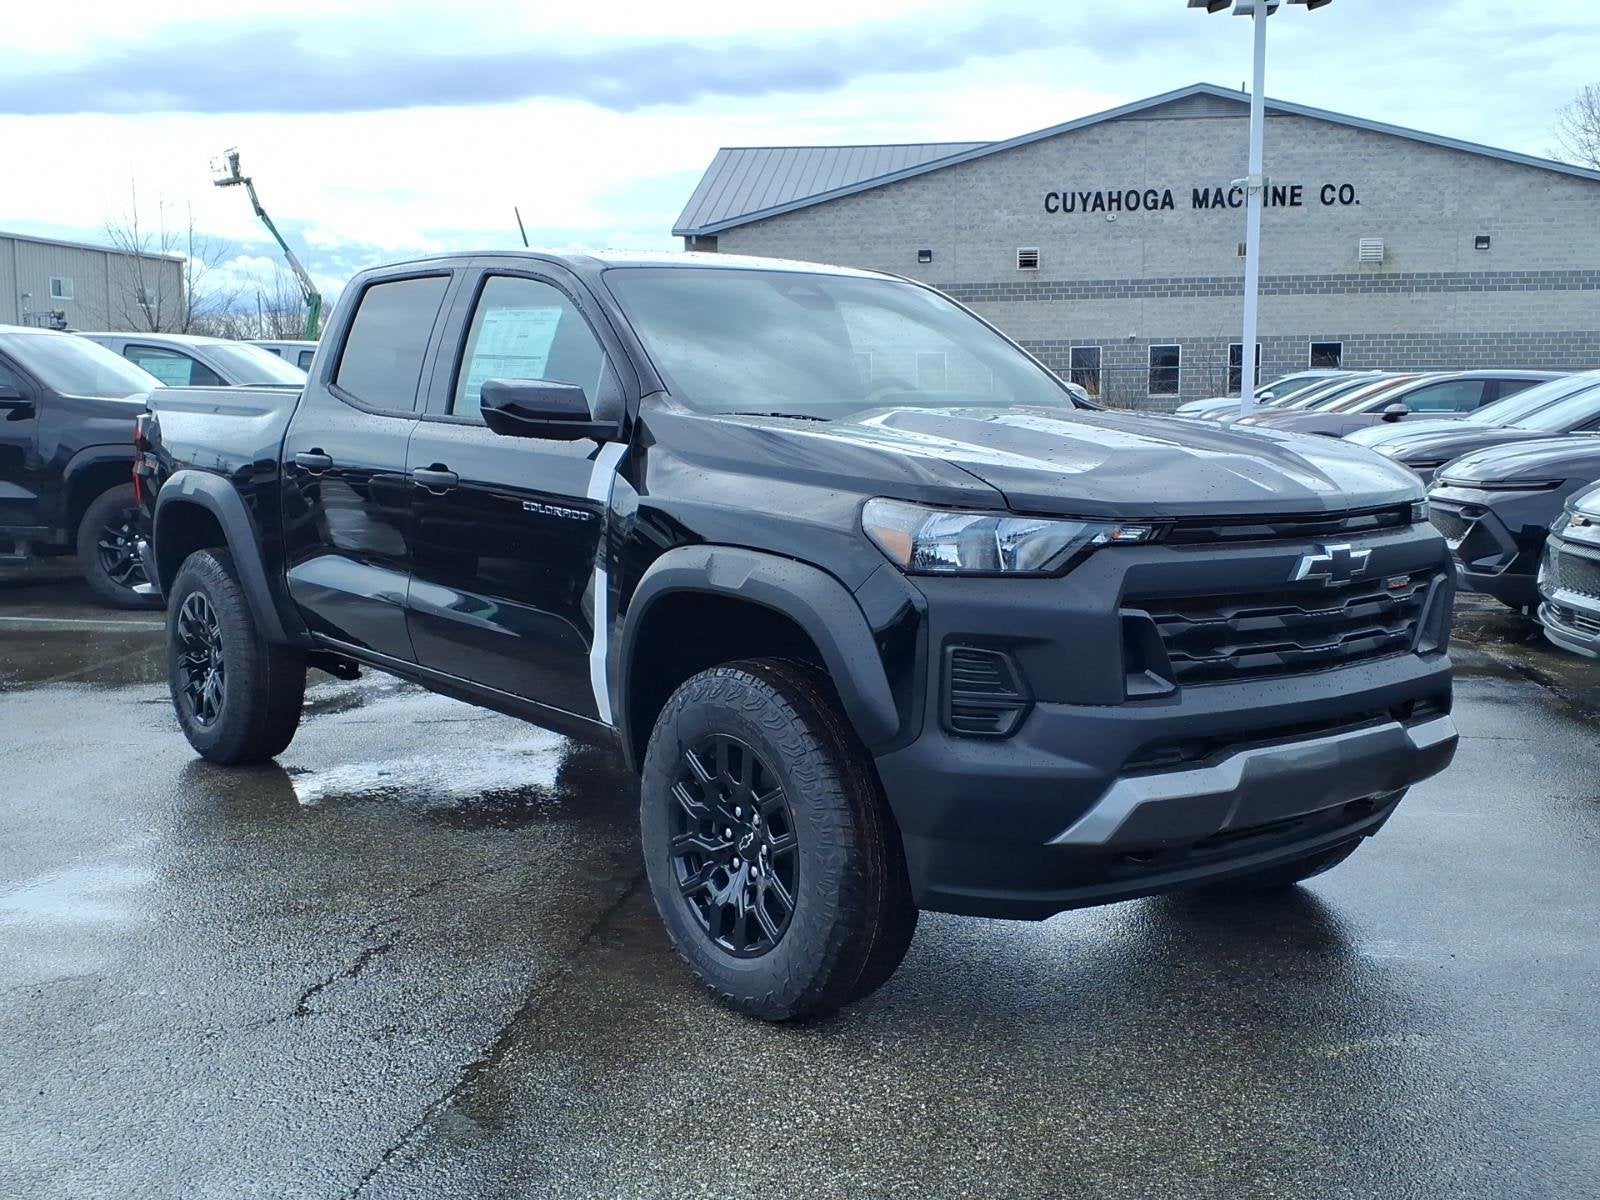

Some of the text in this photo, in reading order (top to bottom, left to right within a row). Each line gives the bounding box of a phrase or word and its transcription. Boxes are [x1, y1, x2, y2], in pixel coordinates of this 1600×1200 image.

[1044, 183, 1360, 213] CUYAHOGA MACINE CO.
[522, 501, 590, 521] COLORADO
